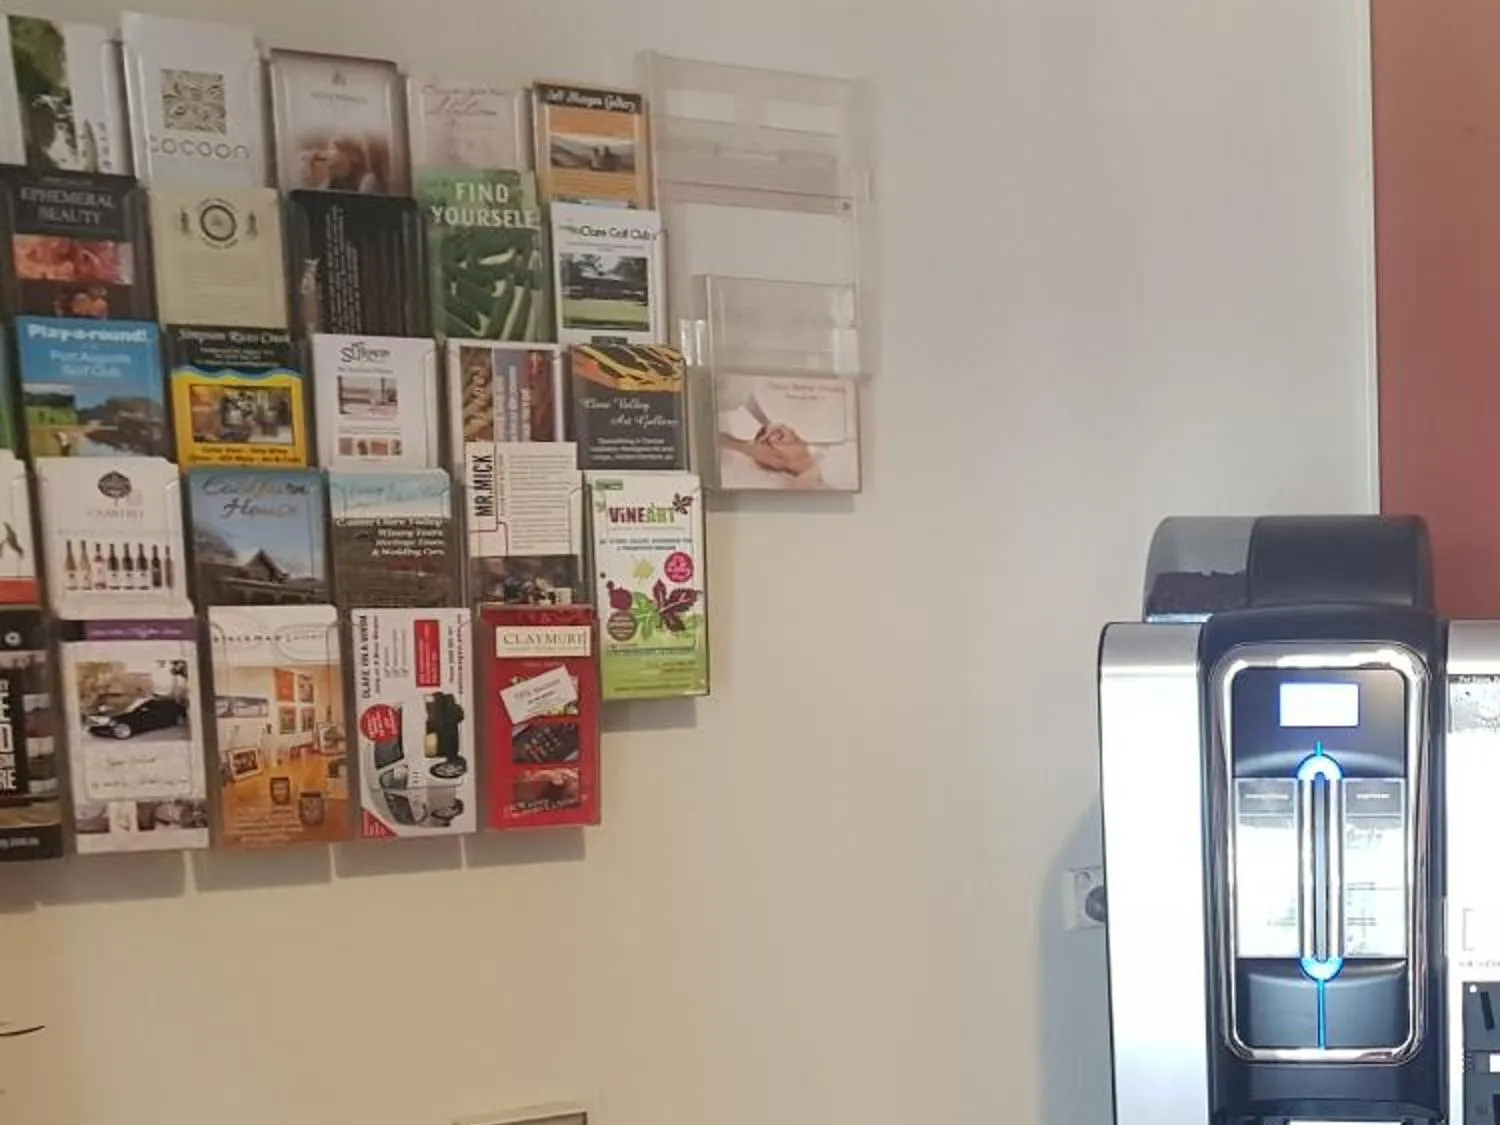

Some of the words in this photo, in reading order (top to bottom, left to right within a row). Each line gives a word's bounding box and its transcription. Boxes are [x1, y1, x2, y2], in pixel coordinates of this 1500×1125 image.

[604, 95, 636, 112] Gallery
[20, 186, 116, 209] EPHEMERAL
[456, 182, 509, 204] FIND
[37, 205, 102, 225] BEAUTY
[430, 205, 537, 229] YOURSELF
[580, 225, 607, 238] Clare
[475, 454, 494, 518] MR.MICK
